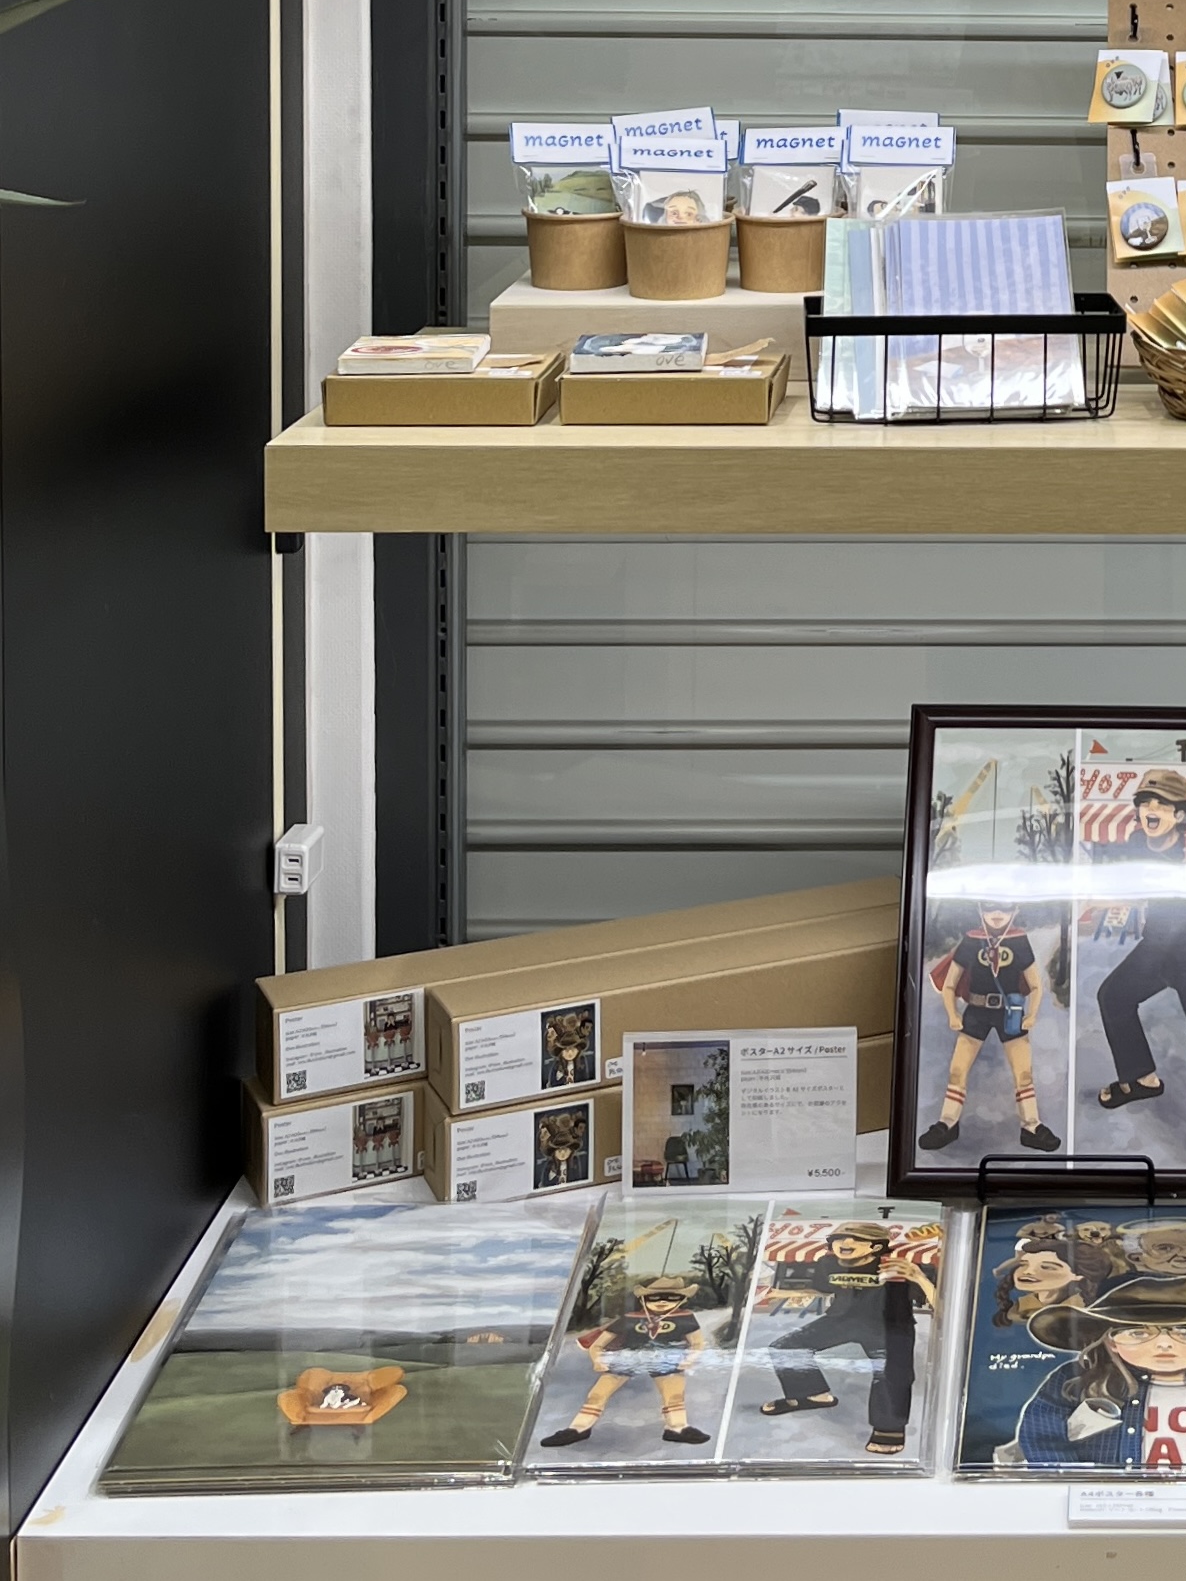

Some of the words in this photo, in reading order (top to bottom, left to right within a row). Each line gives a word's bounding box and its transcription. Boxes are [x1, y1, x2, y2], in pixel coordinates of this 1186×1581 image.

[624, 117, 704, 140] magnet
[523, 131, 605, 151] magnet
[755, 133, 836, 152] magnet
[861, 132, 943, 152] magnet
[631, 145, 715, 161] magnet
